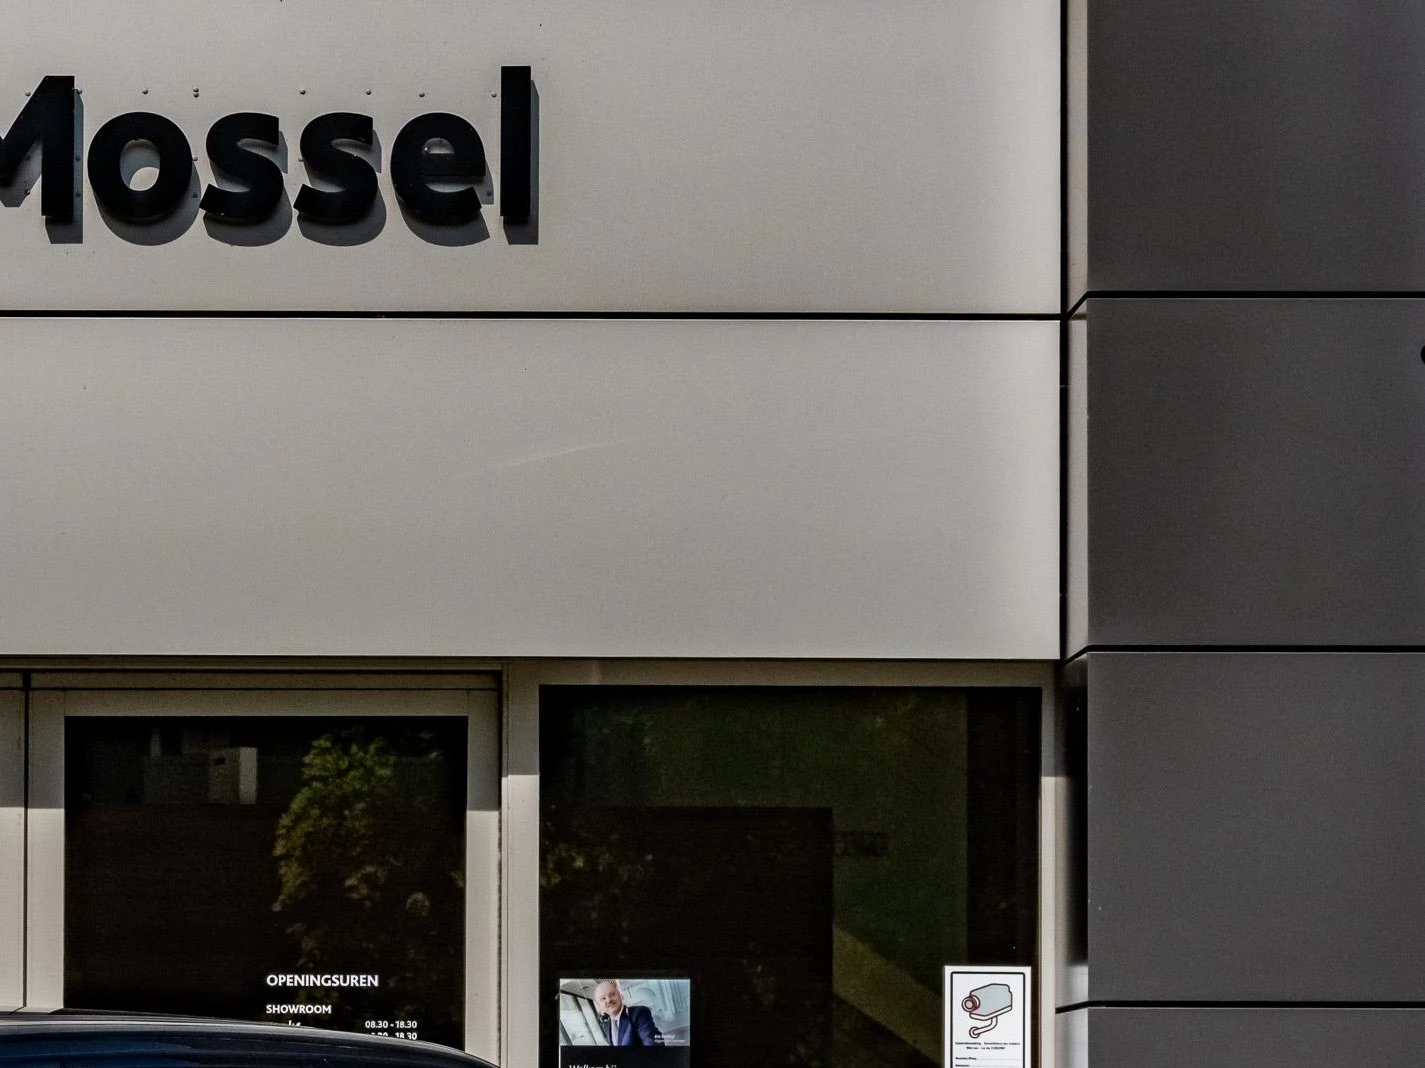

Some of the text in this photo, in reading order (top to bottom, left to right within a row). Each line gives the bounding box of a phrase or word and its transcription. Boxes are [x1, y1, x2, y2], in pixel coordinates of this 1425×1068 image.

[266, 974, 379, 987] OPENINGSUREN
[266, 1004, 332, 1014] SHOWROOM
[365, 1020, 388, 1028] 08.30
[395, 1020, 417, 1028] 18.30
[395, 1032, 417, 1040] 1830
